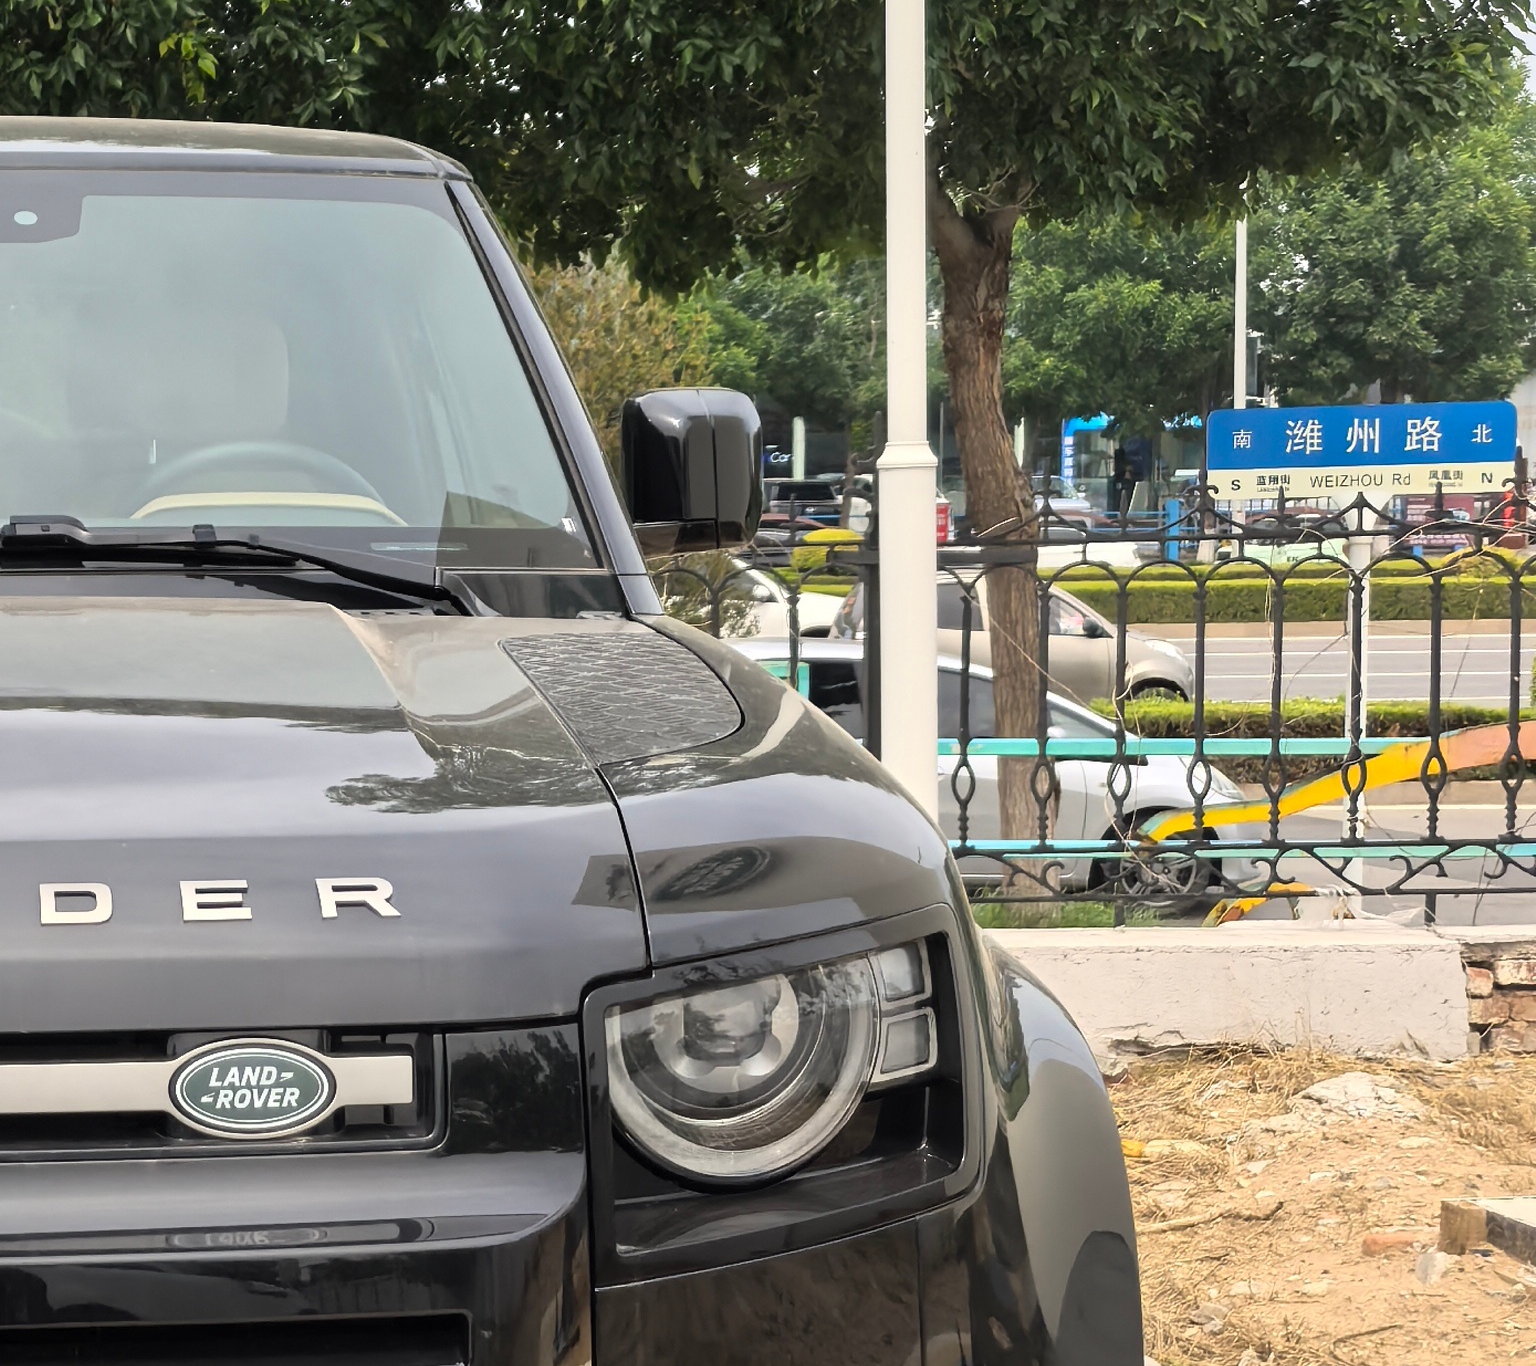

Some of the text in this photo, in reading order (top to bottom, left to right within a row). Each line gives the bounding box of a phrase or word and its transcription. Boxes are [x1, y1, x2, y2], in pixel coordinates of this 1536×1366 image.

[1232, 416, 1493, 455] 南 潍州路 北
[1231, 479, 1241, 491] S
[1309, 472, 1384, 489] WEIZHOU
[1392, 472, 1411, 487] Rd
[1481, 472, 1493, 484] N
[208, 1066, 278, 1087] LAND
[215, 1087, 301, 1109] ROVER
